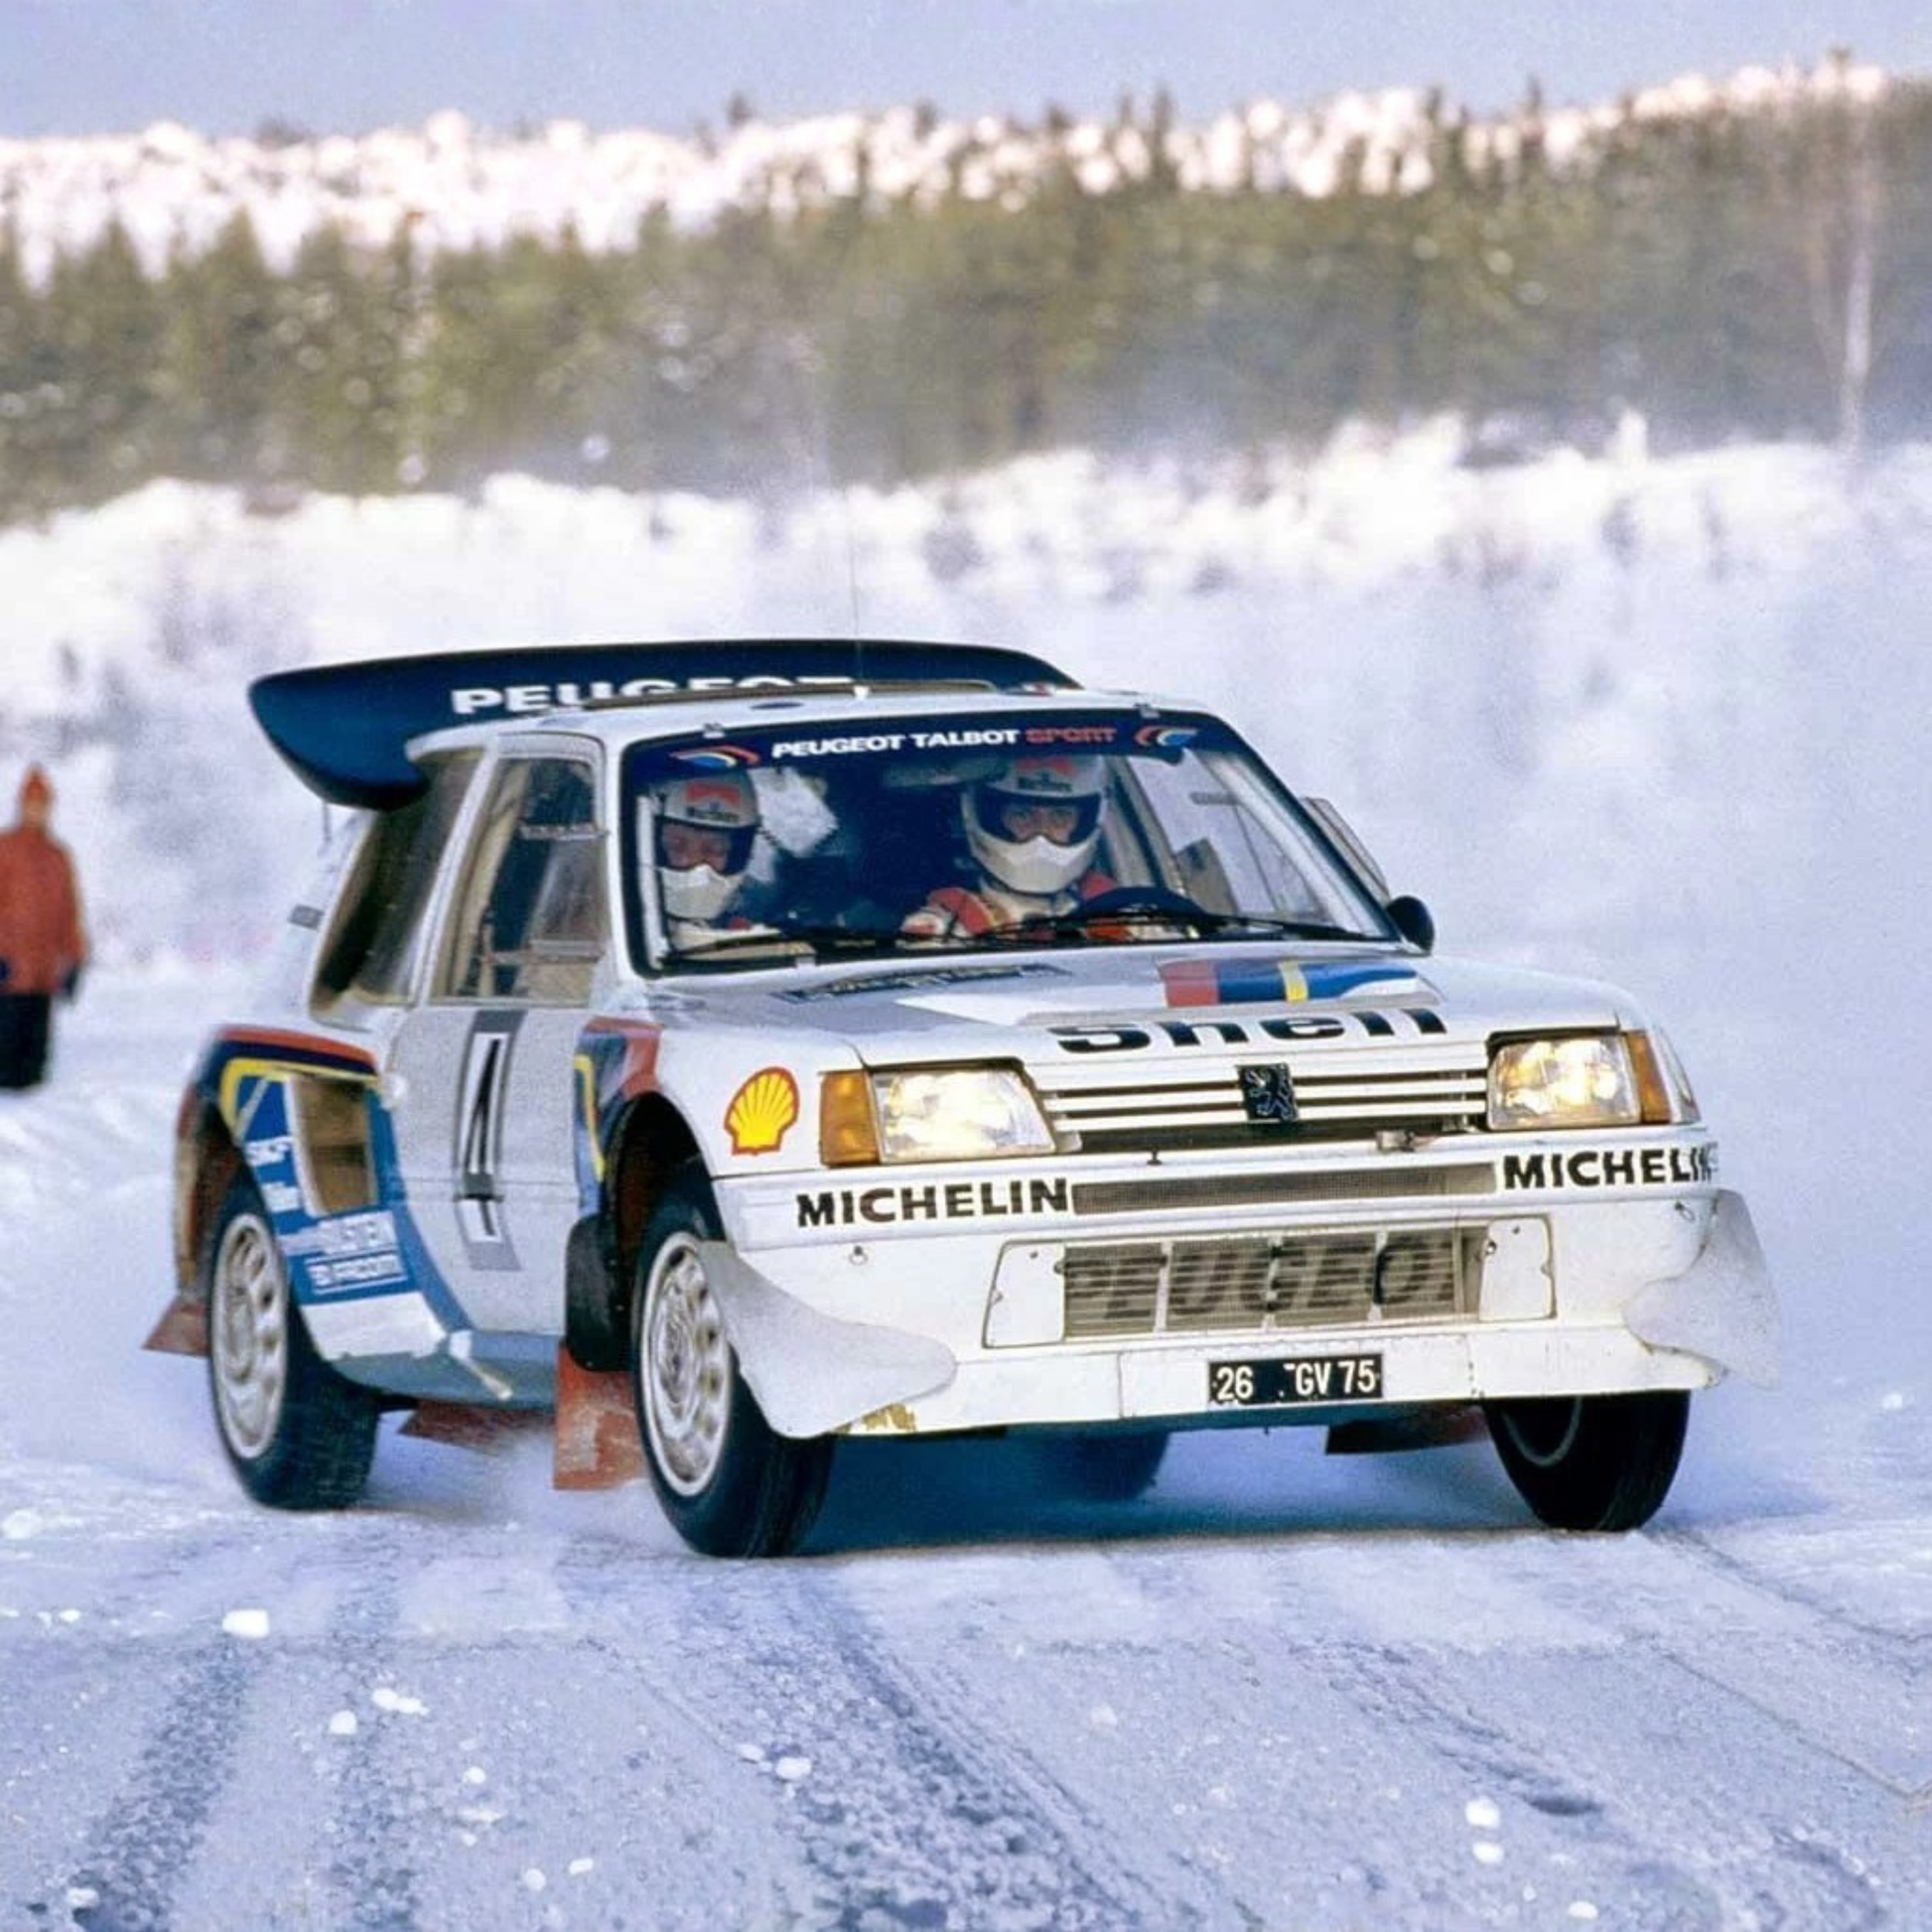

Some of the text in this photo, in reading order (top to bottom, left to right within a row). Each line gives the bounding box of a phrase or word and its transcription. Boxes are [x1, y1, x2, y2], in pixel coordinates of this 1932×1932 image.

[452, 676, 853, 714] PEUG
[771, 727, 1117, 758] PEUGEOT TALBOT SPORT
[796, 1178, 1069, 1228] MICHELIN
[1216, 1365, 1254, 1401] 26
[1337, 1359, 1376, 1394] 75
